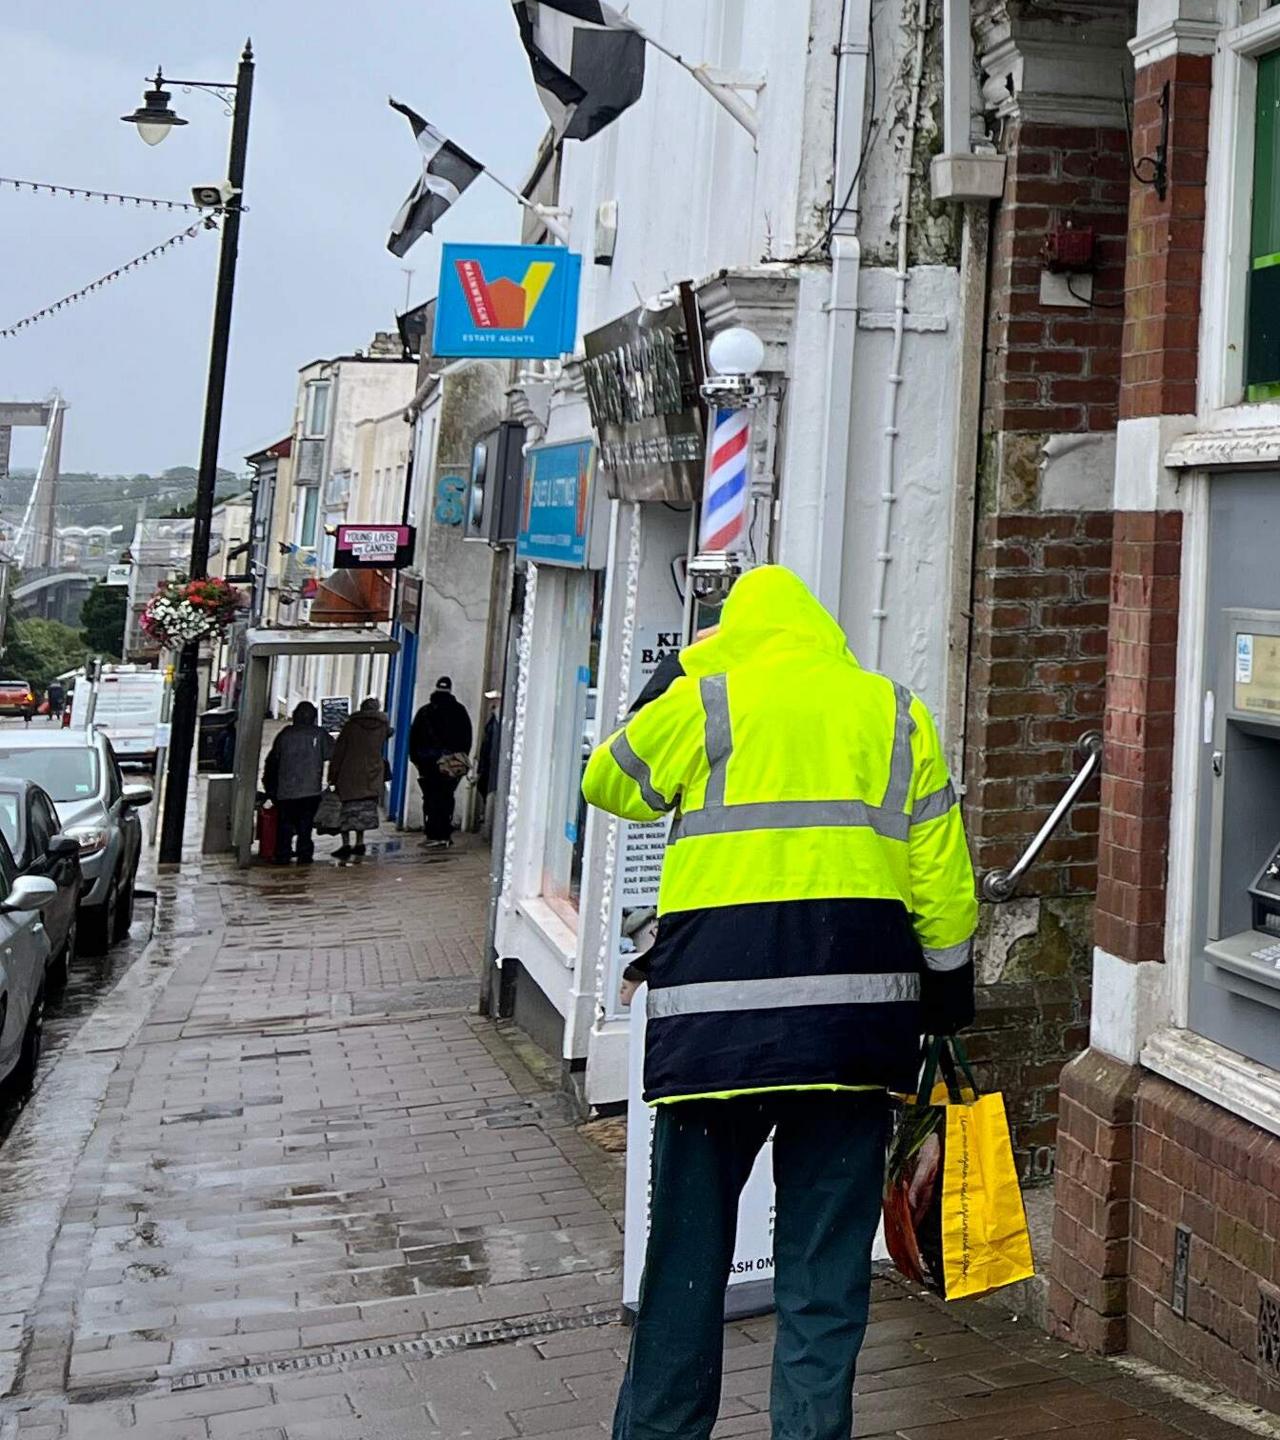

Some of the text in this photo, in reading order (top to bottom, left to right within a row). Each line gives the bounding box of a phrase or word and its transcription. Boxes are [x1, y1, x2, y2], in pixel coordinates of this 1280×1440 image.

[346, 532, 395, 542] YOUNG LIVES
[365, 544, 394, 553] CANCER
[657, 633, 682, 647] KI
[641, 649, 680, 663] BA
[730, 1258, 775, 1273] ASH ON
